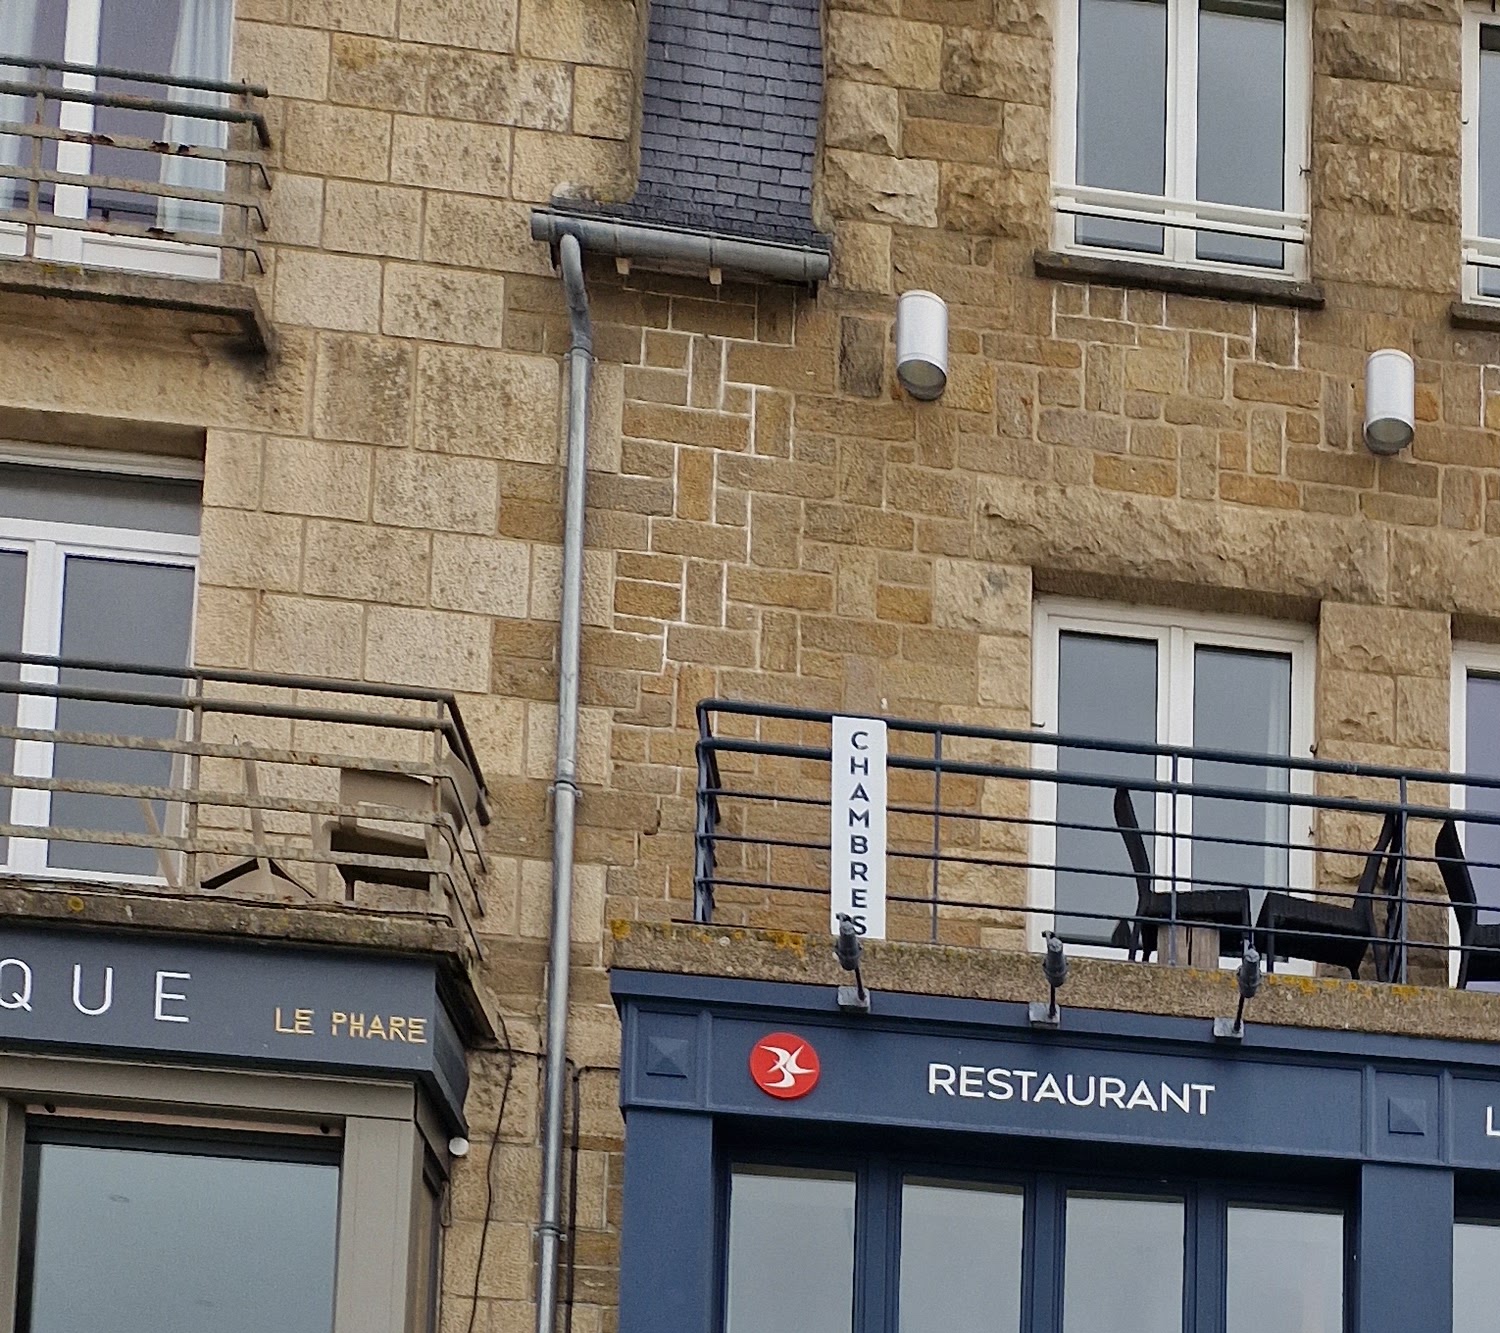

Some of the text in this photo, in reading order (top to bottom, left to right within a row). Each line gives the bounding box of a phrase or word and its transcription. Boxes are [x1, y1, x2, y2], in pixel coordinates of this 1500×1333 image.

[848, 730, 870, 936] CHAMBRES
[275, 1006, 428, 1044] LE PHARE
[927, 1062, 1216, 1116] RESTAURANT
